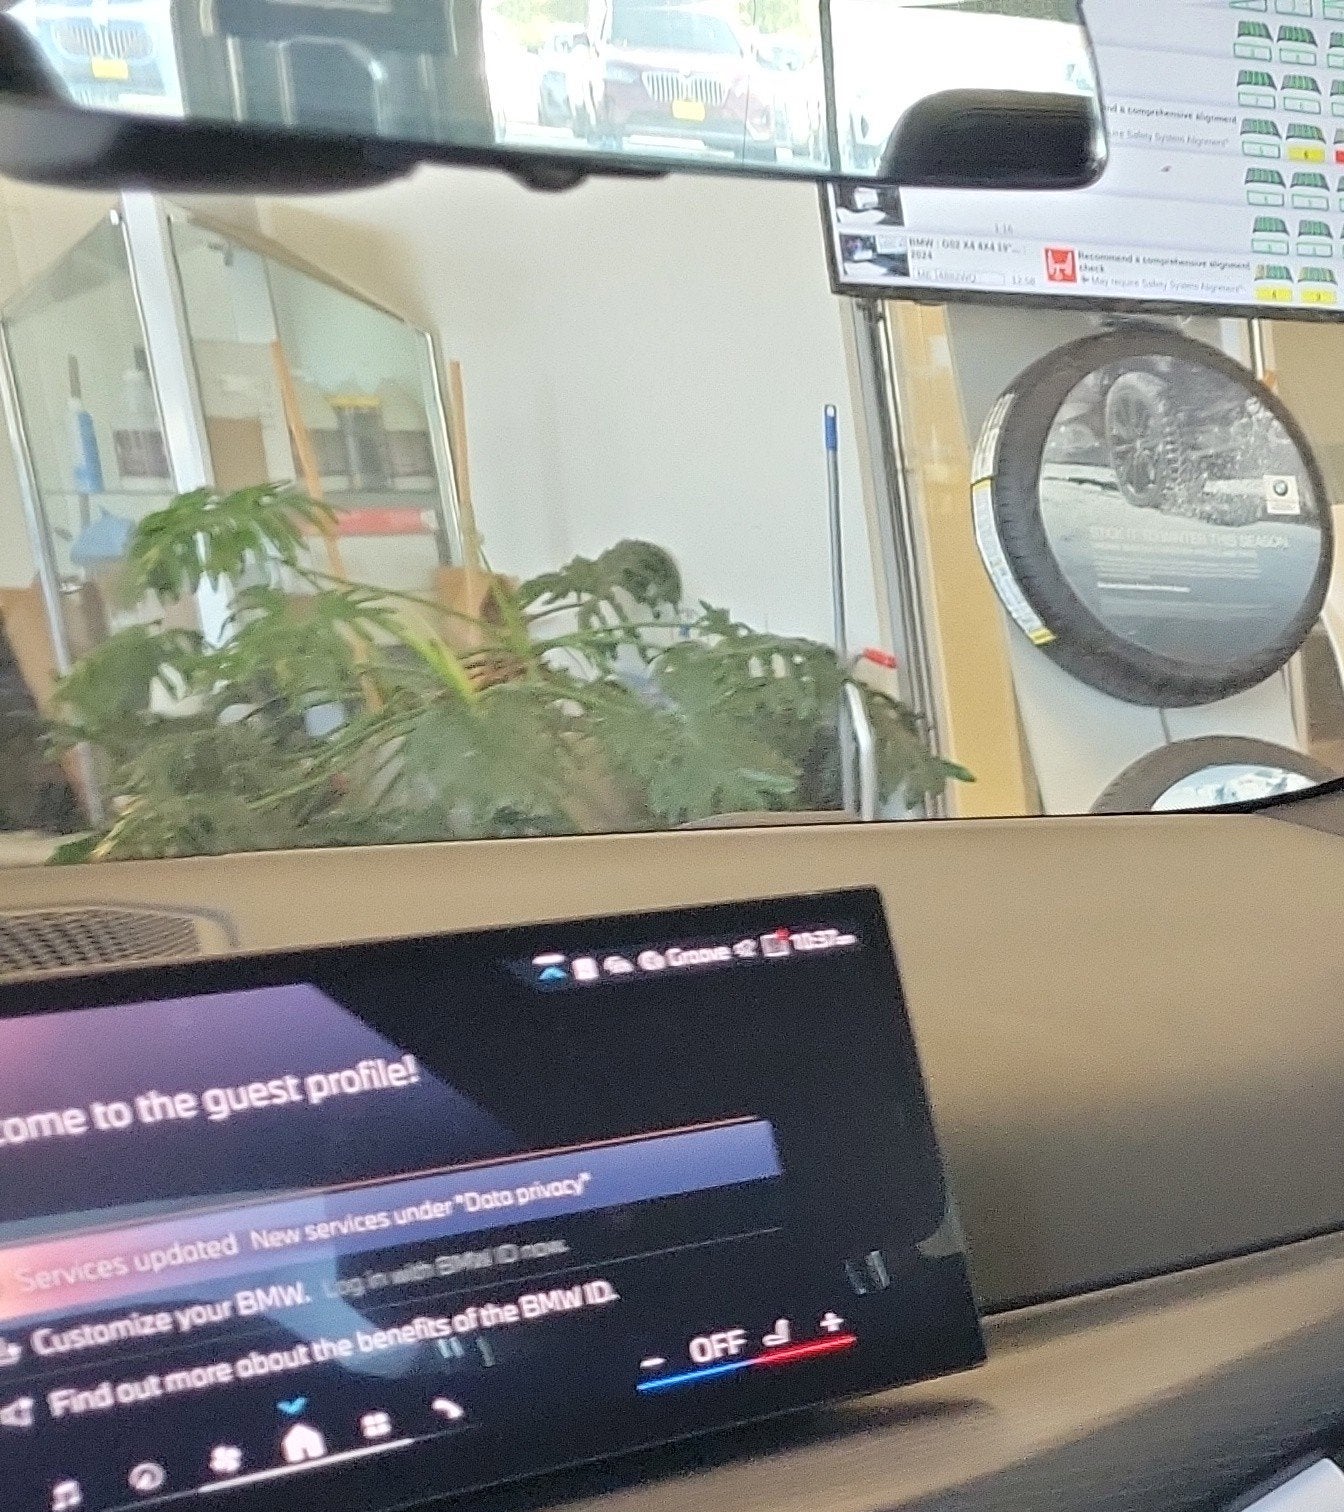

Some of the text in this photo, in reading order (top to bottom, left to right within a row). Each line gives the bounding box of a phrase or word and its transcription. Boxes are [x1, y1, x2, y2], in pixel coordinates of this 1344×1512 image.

[90, 1099, 133, 1131] to
[137, 1089, 200, 1124] the
[202, 1074, 303, 1121] guest
[305, 1054, 421, 1106] profile!
[16, 1256, 129, 1293] Services
[134, 1232, 239, 1274] updated
[251, 1224, 300, 1252] New
[305, 1210, 392, 1242] services
[394, 1198, 452, 1226] under
[31, 1312, 173, 1357] Customize
[175, 1299, 234, 1333] your
[235, 1281, 313, 1318] BMW.
[47, 1382, 114, 1418] Find
[117, 1373, 163, 1405] out
[164, 1361, 235, 1394] more
[236, 1342, 311, 1381] about
[312, 1335, 352, 1361] the
[357, 1315, 452, 1354] benefits
[452, 1305, 478, 1333] of
[479, 1305, 519, 1329] the
[518, 1288, 582, 1320] BMW
[689, 1328, 748, 1363] OFF
